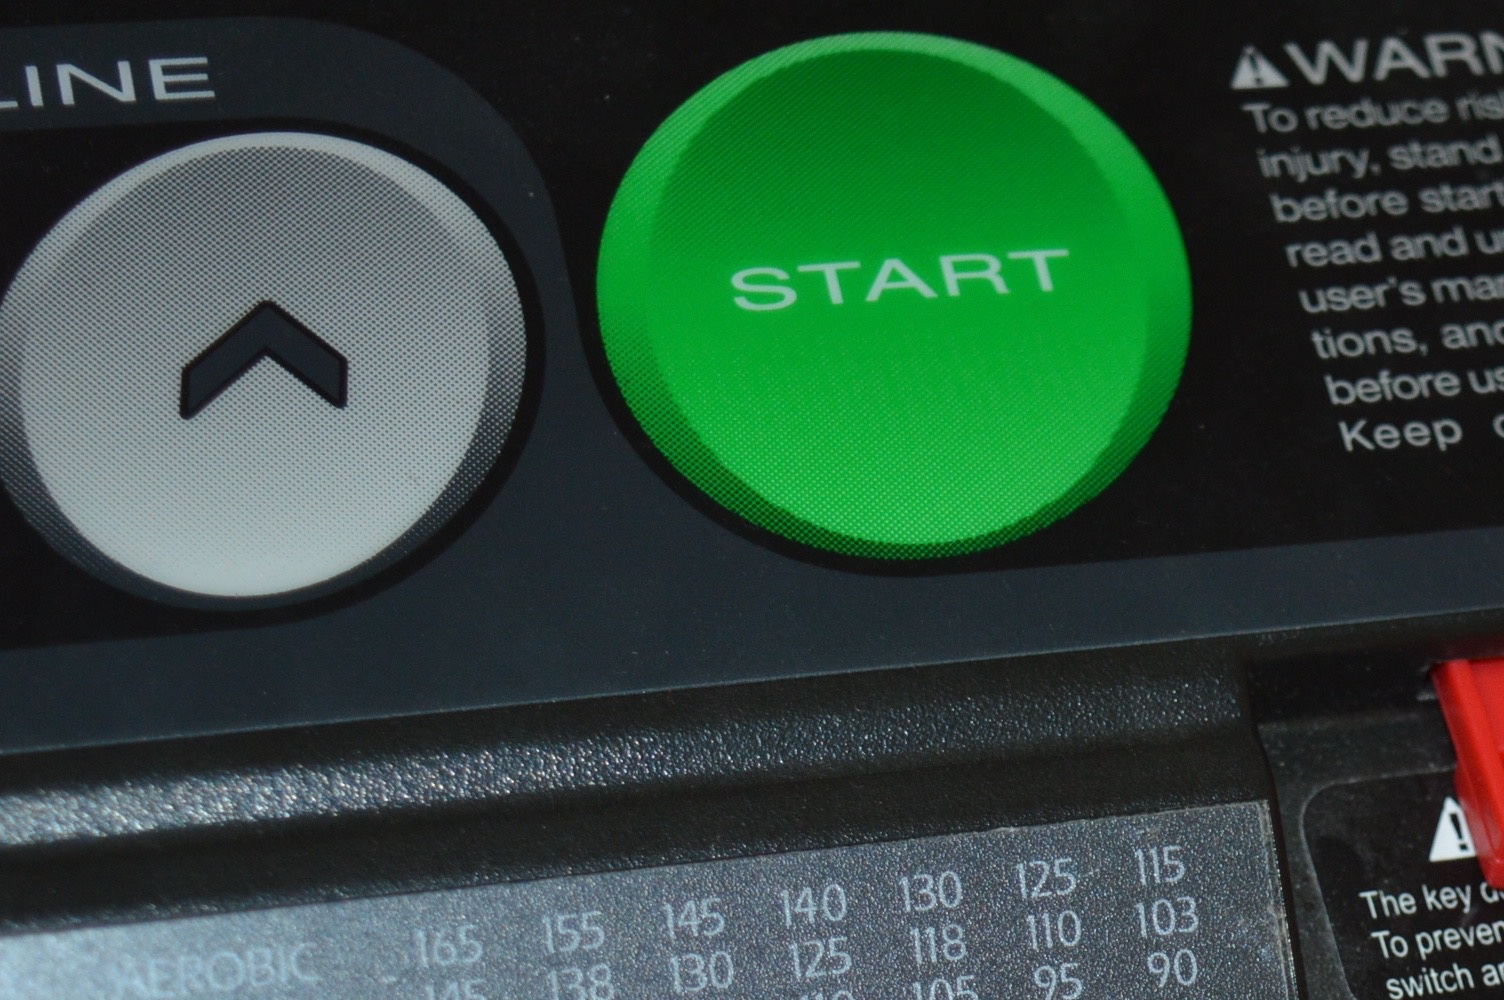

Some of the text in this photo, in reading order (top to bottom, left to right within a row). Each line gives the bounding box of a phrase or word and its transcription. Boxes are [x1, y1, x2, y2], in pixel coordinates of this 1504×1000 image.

[1244, 103, 1298, 134] To
[1306, 97, 1449, 131] reduce
[1258, 147, 1382, 183] injury,
[1389, 134, 1503, 171] stand
[1271, 187, 1409, 223] before
[1286, 232, 1382, 267] read
[1390, 227, 1469, 262] and
[730, 248, 1069, 312] START
[1299, 277, 1426, 314] user's
[1311, 324, 1429, 360] tions,
[1324, 370, 1461, 406] before
[1338, 412, 1463, 452] Keep
[1360, 887, 1416, 920] The
[1422, 880, 1471, 913] key
[116, 845, 1187, 1000] AEROBIC 165 155 145 140 130 125 115
[671, 951, 735, 993] 130
[790, 936, 852, 979] 125
[911, 923, 967, 965] 118
[1027, 910, 1082, 951] 110
[1136, 896, 1199, 938] 103
[1372, 927, 1409, 959] To
[1147, 947, 1199, 990] 90
